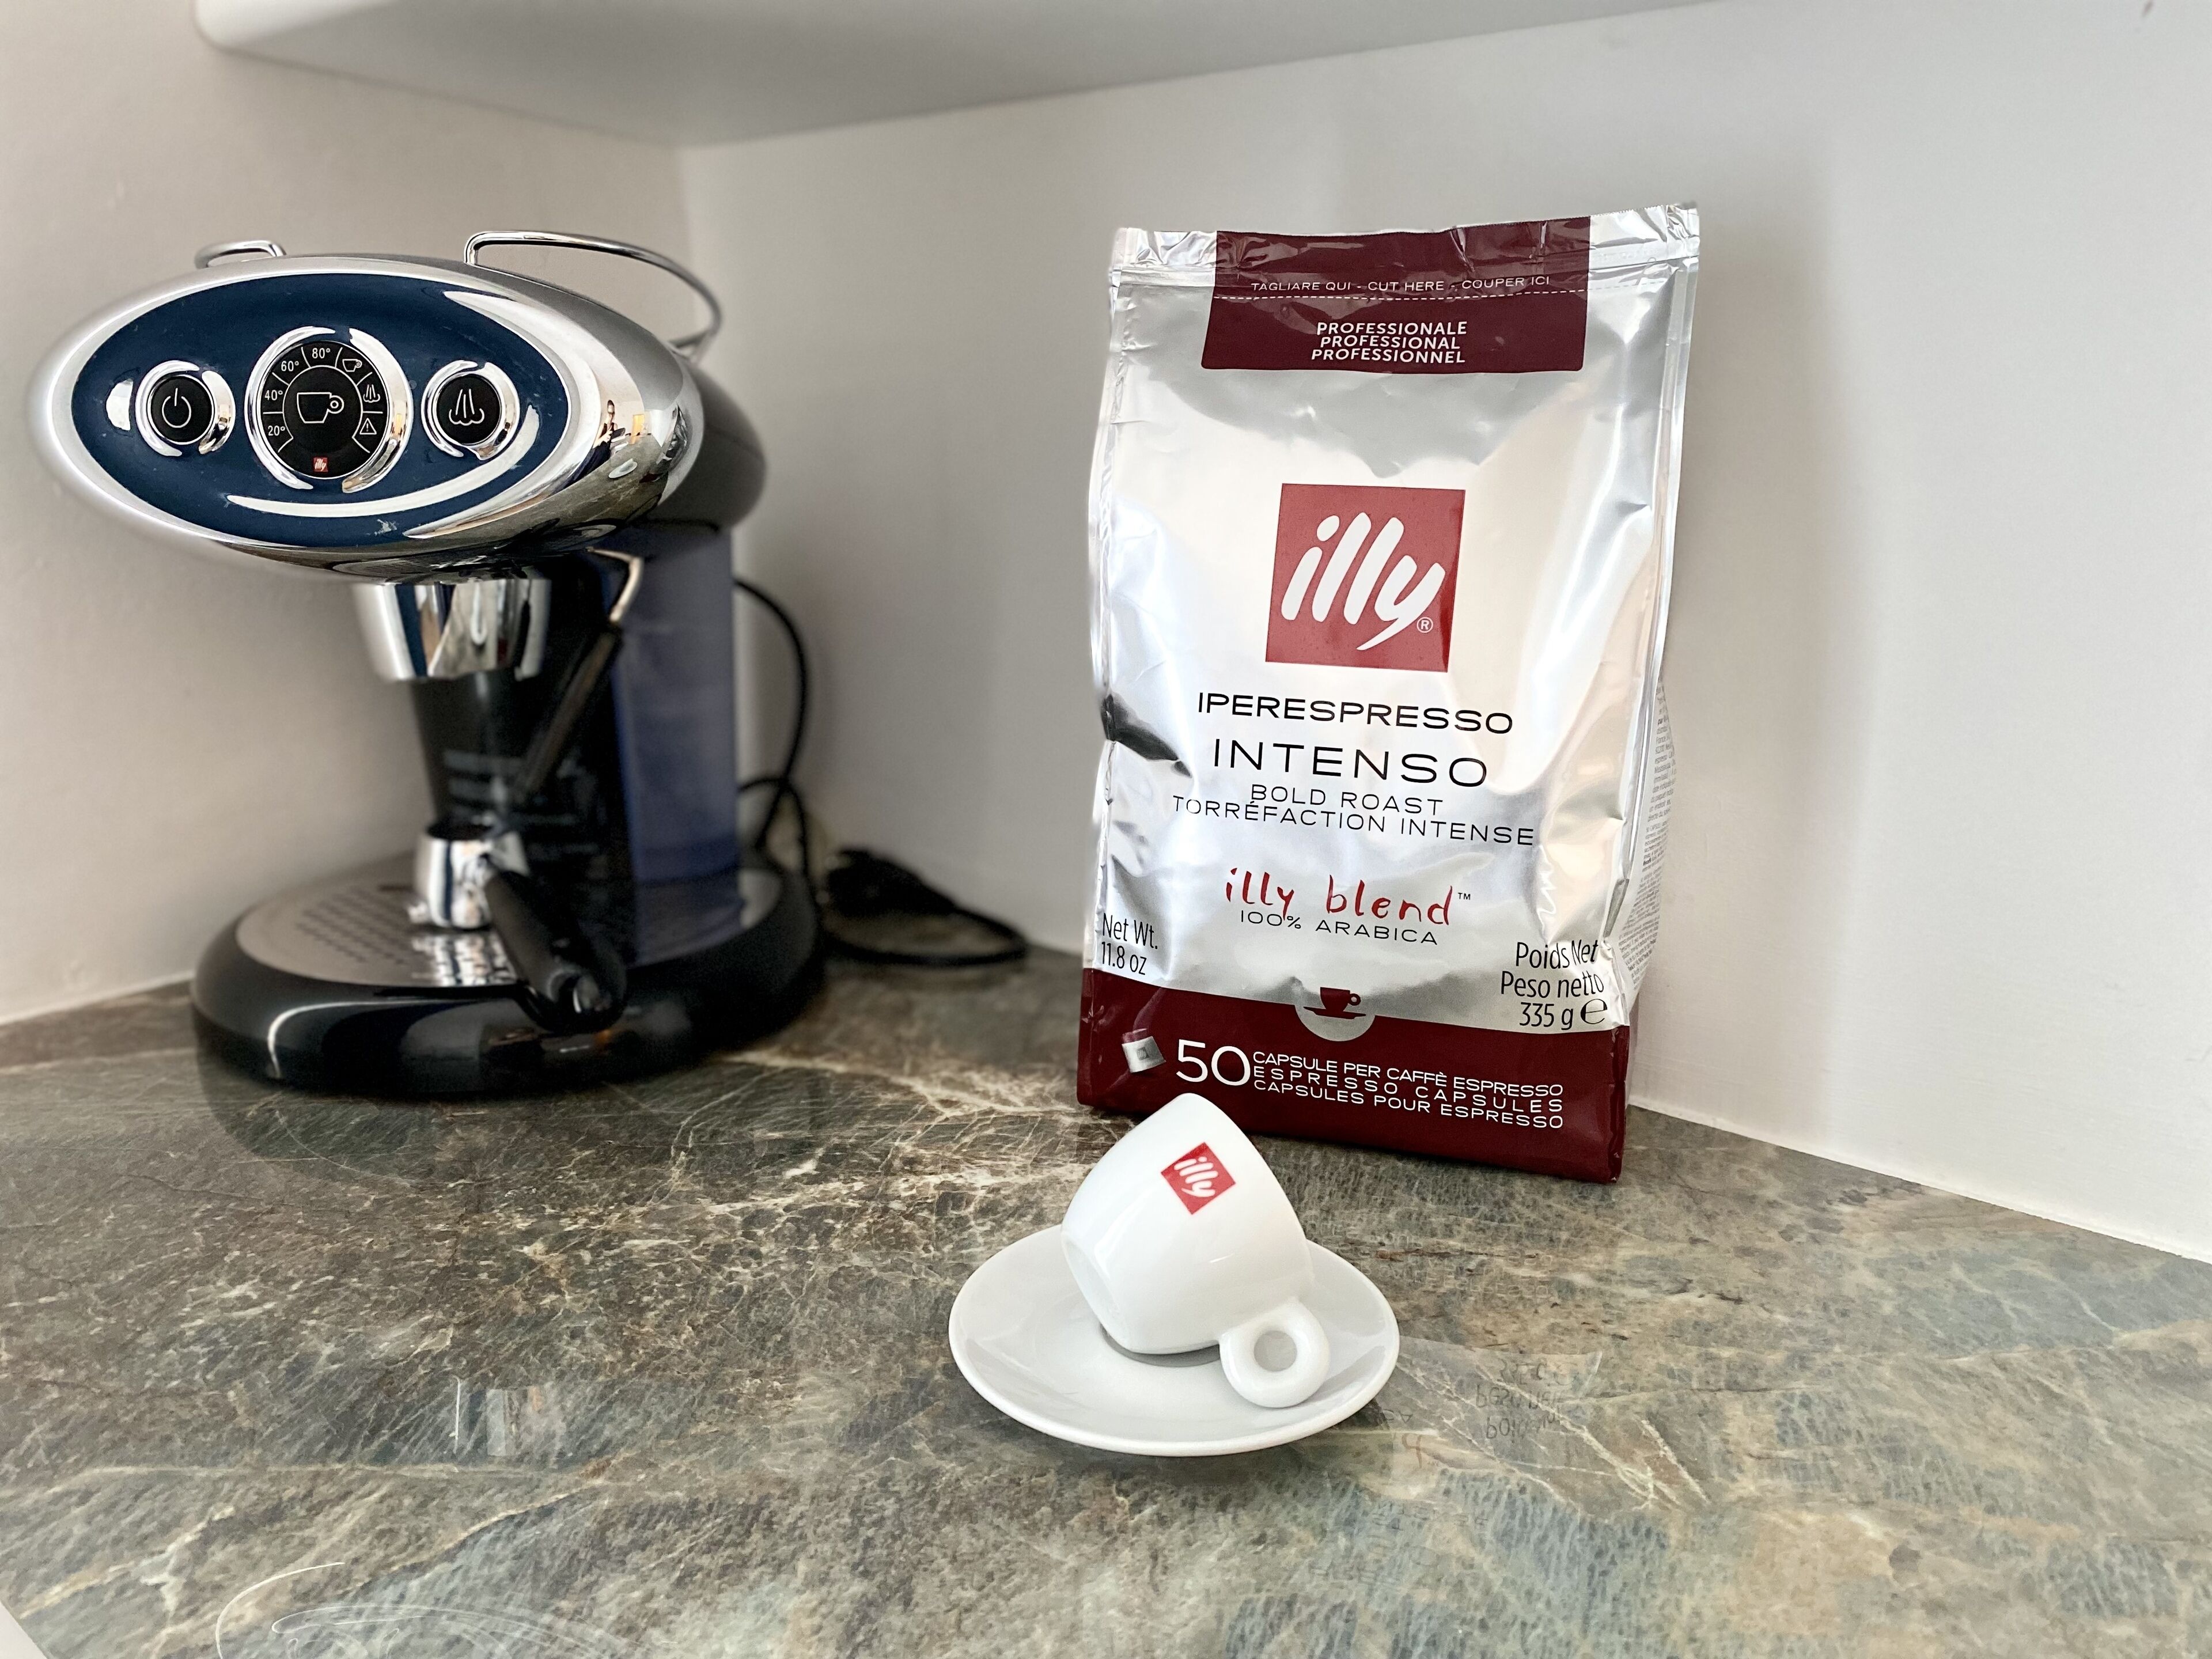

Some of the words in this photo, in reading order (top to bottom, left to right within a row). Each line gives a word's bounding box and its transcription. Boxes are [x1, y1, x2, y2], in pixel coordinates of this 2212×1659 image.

[1251, 282, 1320, 291] TAGLIARE
[1325, 281, 1351, 290] QUI
[1368, 282, 1397, 291] CUT
[1404, 281, 1444, 291] HERE
[1461, 277, 1524, 289] COUPER
[1531, 276, 1550, 286] ICI
[1316, 321, 1467, 335] PROFESSIONALE
[1320, 335, 1460, 349] PROFESSIONAL
[1311, 349, 1465, 363] PROFESSIONNEL
[315, 458, 327, 471] illy
[1281, 512, 1446, 651] illy
[1198, 692, 1513, 734] IPERESPRESSO
[1214, 738, 1487, 787] INTENSO
[1251, 784, 1326, 805] BOLD
[1342, 791, 1443, 816] ROAST
[1173, 795, 1385, 832] TORRÉFACTION
[1401, 818, 1534, 846] INTENSE
[1225, 868, 1294, 921] illy
[1325, 874, 1453, 925] blend
[1102, 912, 1128, 941] Net
[1133, 918, 1158, 950] Wt.
[1240, 910, 1301, 929] 100%
[1315, 919, 1438, 945] ARABICA
[1101, 941, 1126, 969] 11.8
[1130, 954, 1146, 975] oz
[1516, 942, 1570, 969] Poids
[1571, 940, 1599, 966] Net
[1501, 971, 1550, 998] Peso
[1558, 970, 1604, 998] netto
[1519, 1002, 1555, 1027] 335
[1561, 1009, 1573, 1031] g
[1176, 1039, 1251, 1086] 50
[1252, 1051, 1338, 1073] CAPSULE
[1344, 1063, 1380, 1078] PER
[1387, 1068, 1447, 1087] CAFFÈ
[1453, 1077, 1563, 1097] ESPRESSO
[1253, 1066, 1397, 1094] ESPRESSO
[1415, 1086, 1562, 1113] CAPSULES
[1253, 1080, 1364, 1104] CAPSULES
[1374, 1097, 1430, 1113] POUR
[1441, 1104, 1563, 1129] ESPRESSO
[1174, 1156, 1218, 1198] illy
